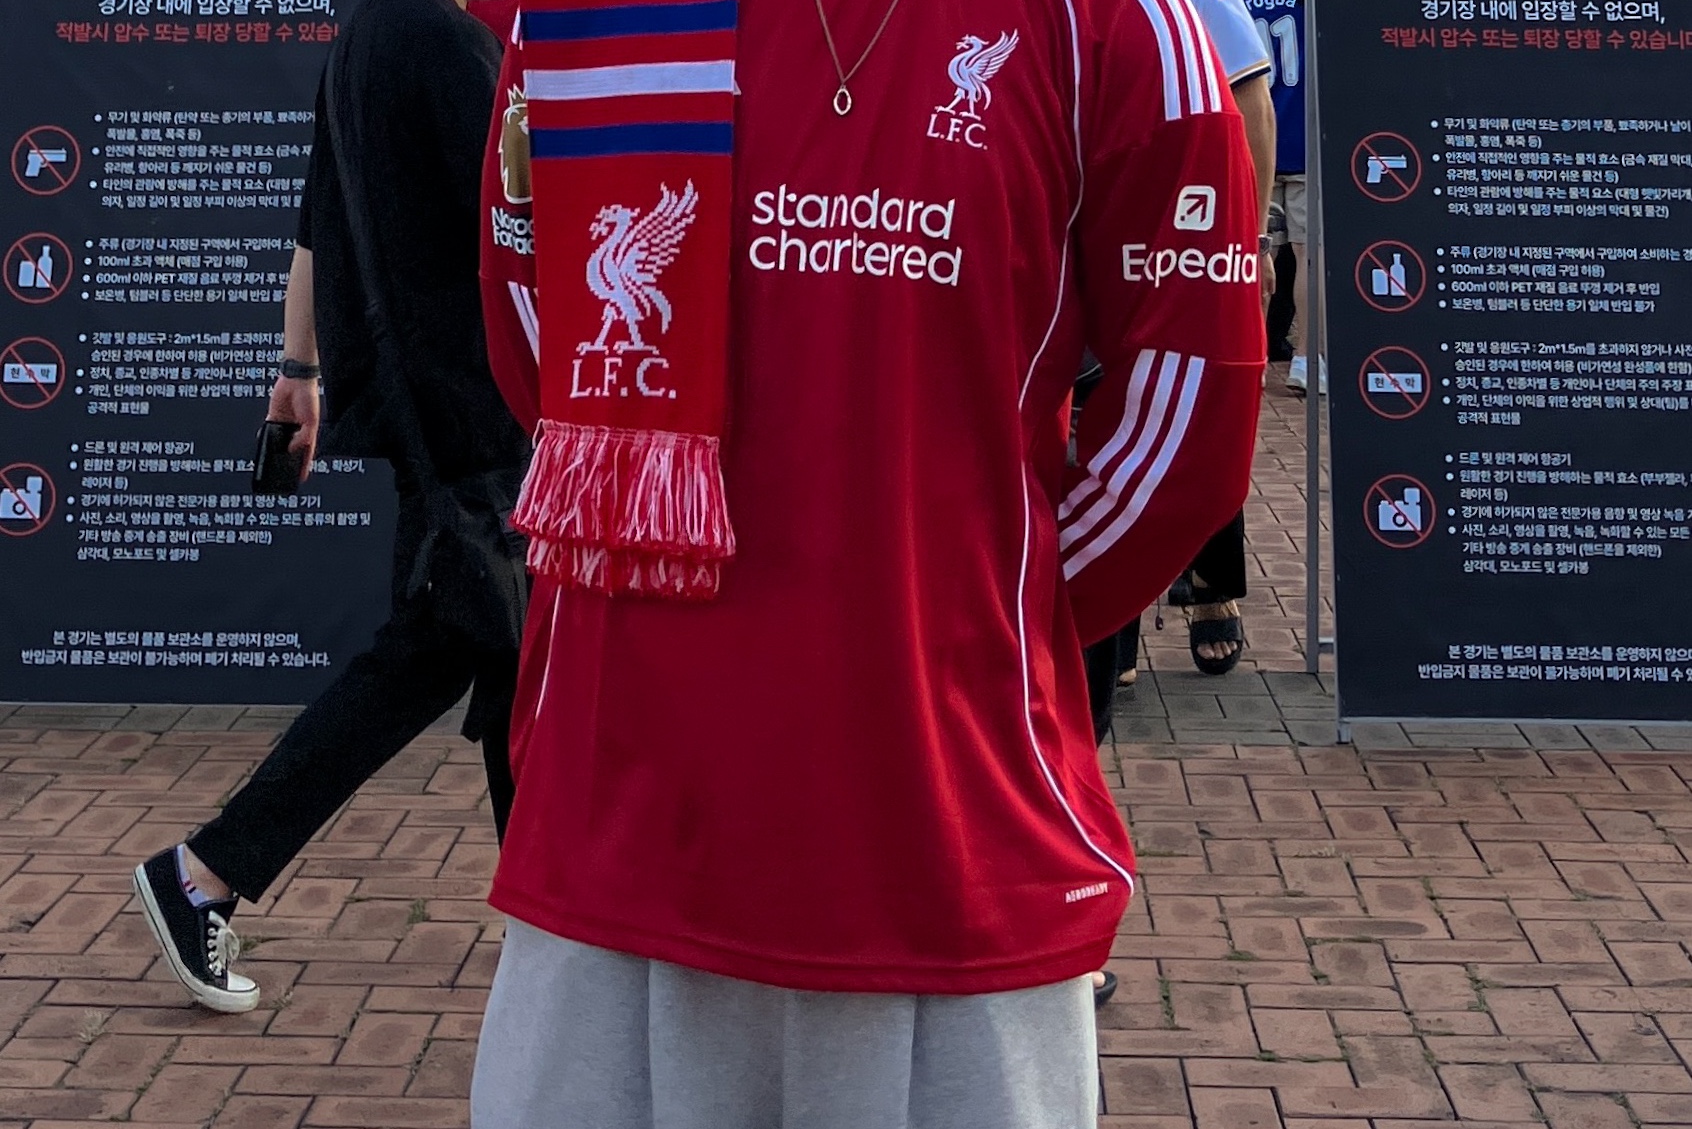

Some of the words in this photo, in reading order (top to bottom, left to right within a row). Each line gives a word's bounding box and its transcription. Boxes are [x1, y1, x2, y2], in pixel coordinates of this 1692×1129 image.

[1421, 0, 1475, 19] 경기장
[1481, 0, 1517, 20] 내에
[1522, 0, 1577, 20] 입장할
[1582, 2, 1600, 20] 수
[1604, 1, 1665, 24] 없으며,
[56, 22, 108, 42] 적발시
[114, 23, 149, 42] 압수
[154, 24, 189, 42] 또는
[195, 23, 230, 42] 퇴장
[236, 22, 271, 42] 당할
[276, 23, 292, 42] 수
[298, 22, 338, 41] 있습
[1382, 28, 1435, 47] 적발시
[1441, 28, 1476, 47] 압수
[1482, 29, 1518, 48] 또는
[1524, 29, 1559, 48] 퇴장
[1565, 29, 1600, 49] 당할
[1607, 30, 1626, 49] 수
[926, 113, 988, 150] L.F.C.
[752, 183, 955, 240] standard
[749, 228, 963, 287] chartered
[10, 368, 51, 379] 현막
[569, 357, 677, 399] L.F.C.
[1374, 377, 1416, 389] 현막
[54, 631, 65, 645] 본
[68, 631, 101, 645] 경기는
[105, 632, 138, 646] 별도의
[142, 632, 165, 646] 물품
[168, 632, 213, 646] 보관소를
[217, 633, 260, 647] 운영하지
[264, 633, 301, 648] 않으며,
[22, 650, 67, 664] 반입금지
[71, 650, 105, 664] 물품은
[108, 651, 142, 665] 보관이
[145, 651, 201, 666] 불가능하며
[205, 651, 228, 666] 폐기
[232, 652, 264, 666] 처리될
[268, 652, 280, 666] 수
[283, 652, 330, 667] 있습니다.
[1449, 645, 1461, 659] 본
[1464, 645, 1498, 659] 경기는
[1501, 645, 1536, 660] 별도의
[1540, 646, 1563, 660] 물품
[1567, 646, 1612, 661] 보관소를
[1616, 647, 1662, 661] 운영하지
[1418, 664, 1465, 678] 반입금지
[1468, 665, 1504, 679] 물품은
[1507, 665, 1541, 679] 보관이
[1545, 666, 1604, 680] 불가능하며
[1607, 666, 1630, 681] 폐기
[1634, 667, 1668, 681] 처리될
[1672, 668, 1683, 682] 수
